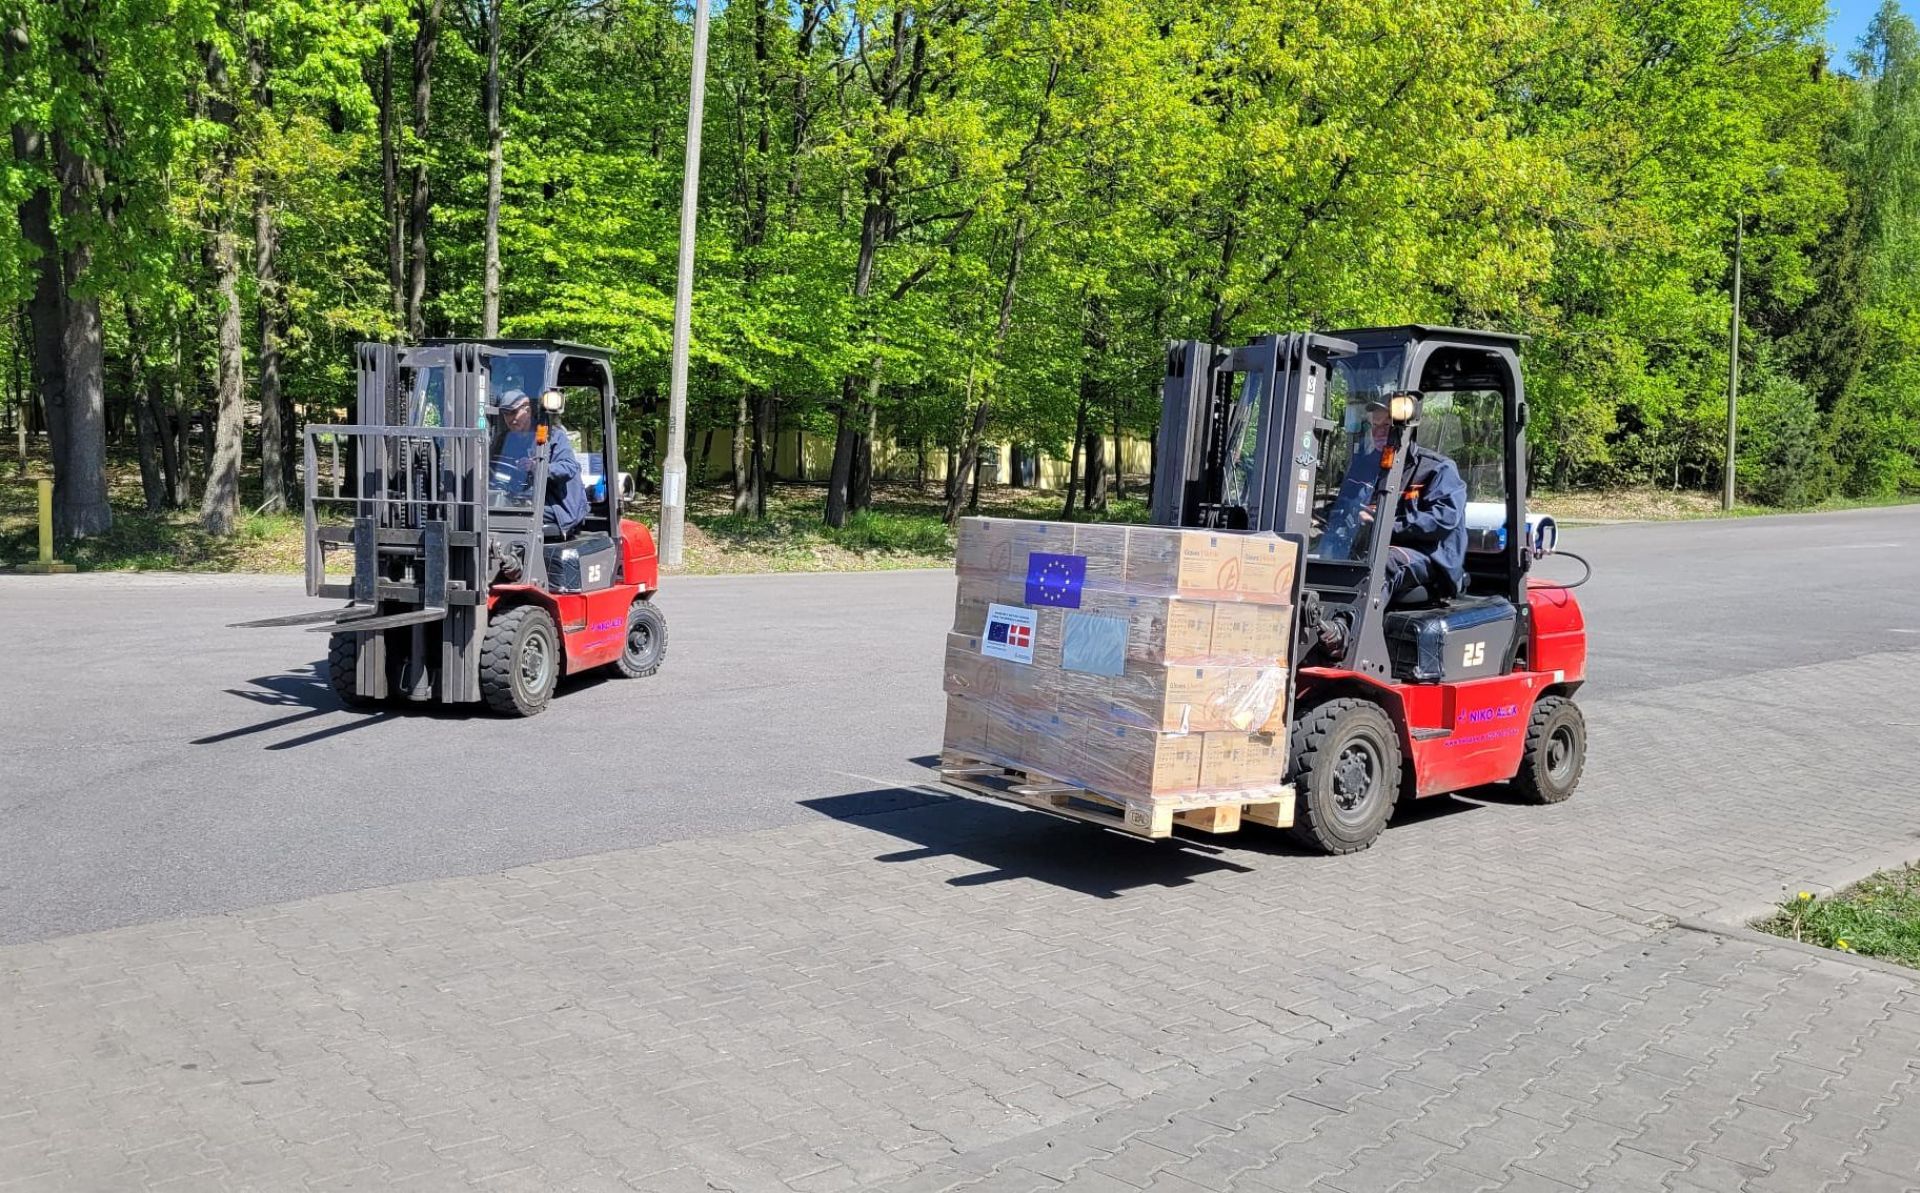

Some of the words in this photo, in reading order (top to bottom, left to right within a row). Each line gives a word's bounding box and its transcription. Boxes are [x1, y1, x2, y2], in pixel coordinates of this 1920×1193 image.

[588, 564, 601, 583] 25
[1462, 641, 1485, 668] 25
[1470, 708, 1494, 721] NIKO
